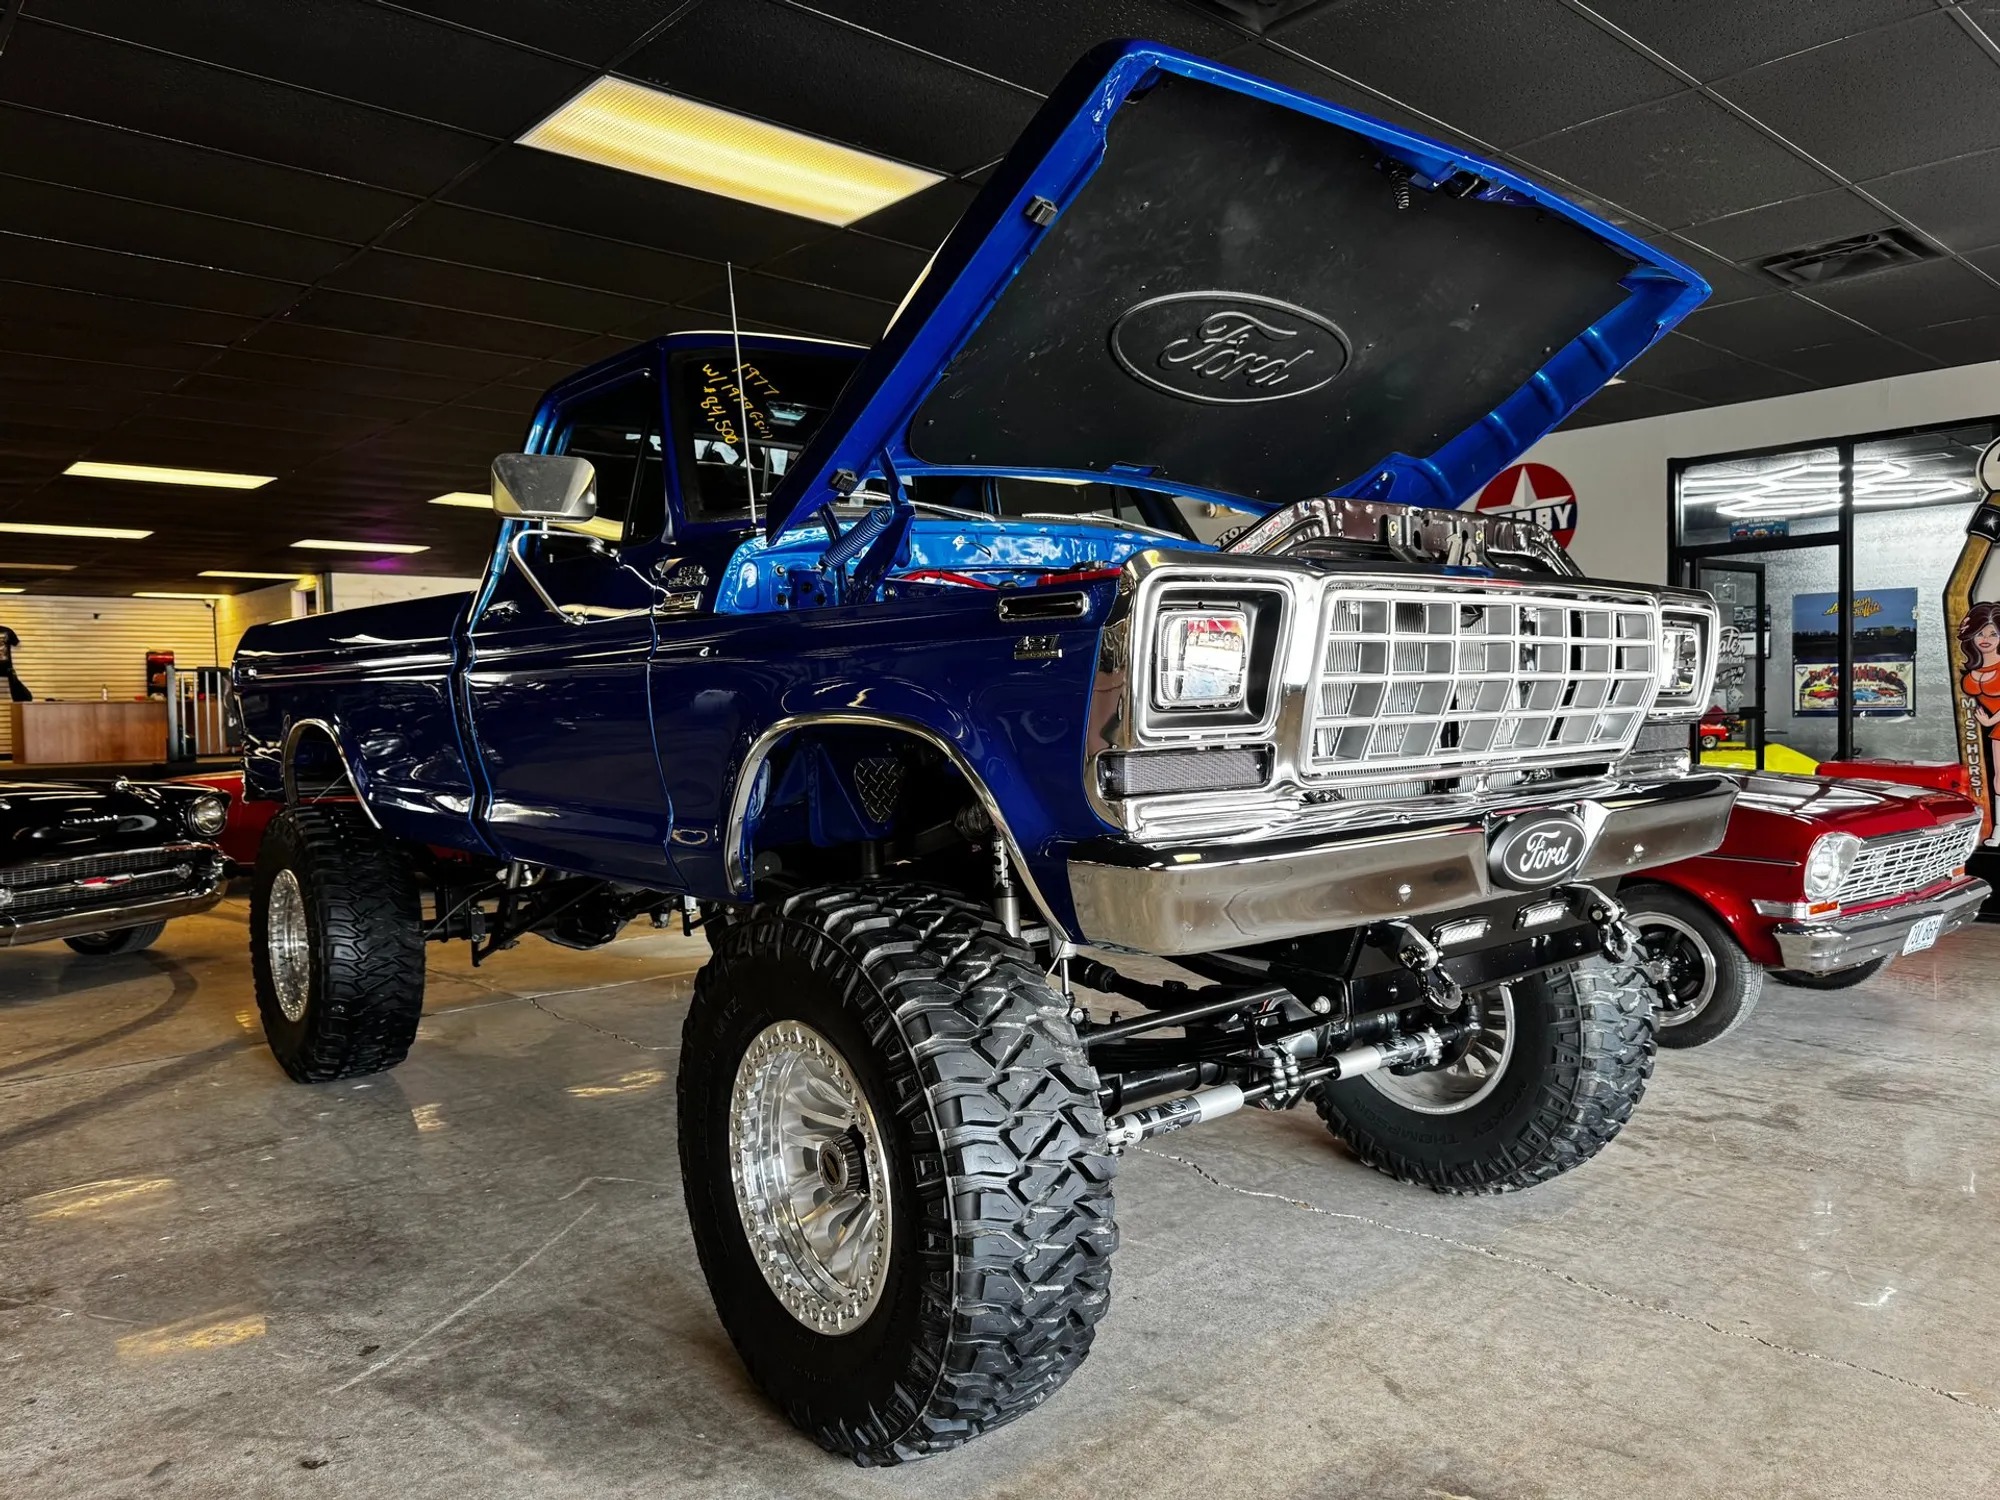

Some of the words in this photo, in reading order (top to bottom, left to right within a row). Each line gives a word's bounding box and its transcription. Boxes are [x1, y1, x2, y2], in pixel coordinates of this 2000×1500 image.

[1160, 310, 1315, 387] Ford
[731, 363, 780, 395] 1977
[1961, 697, 1977, 741] MISS
[1966, 743, 1981, 798] HURST
[1519, 830, 1572, 873] Ford
